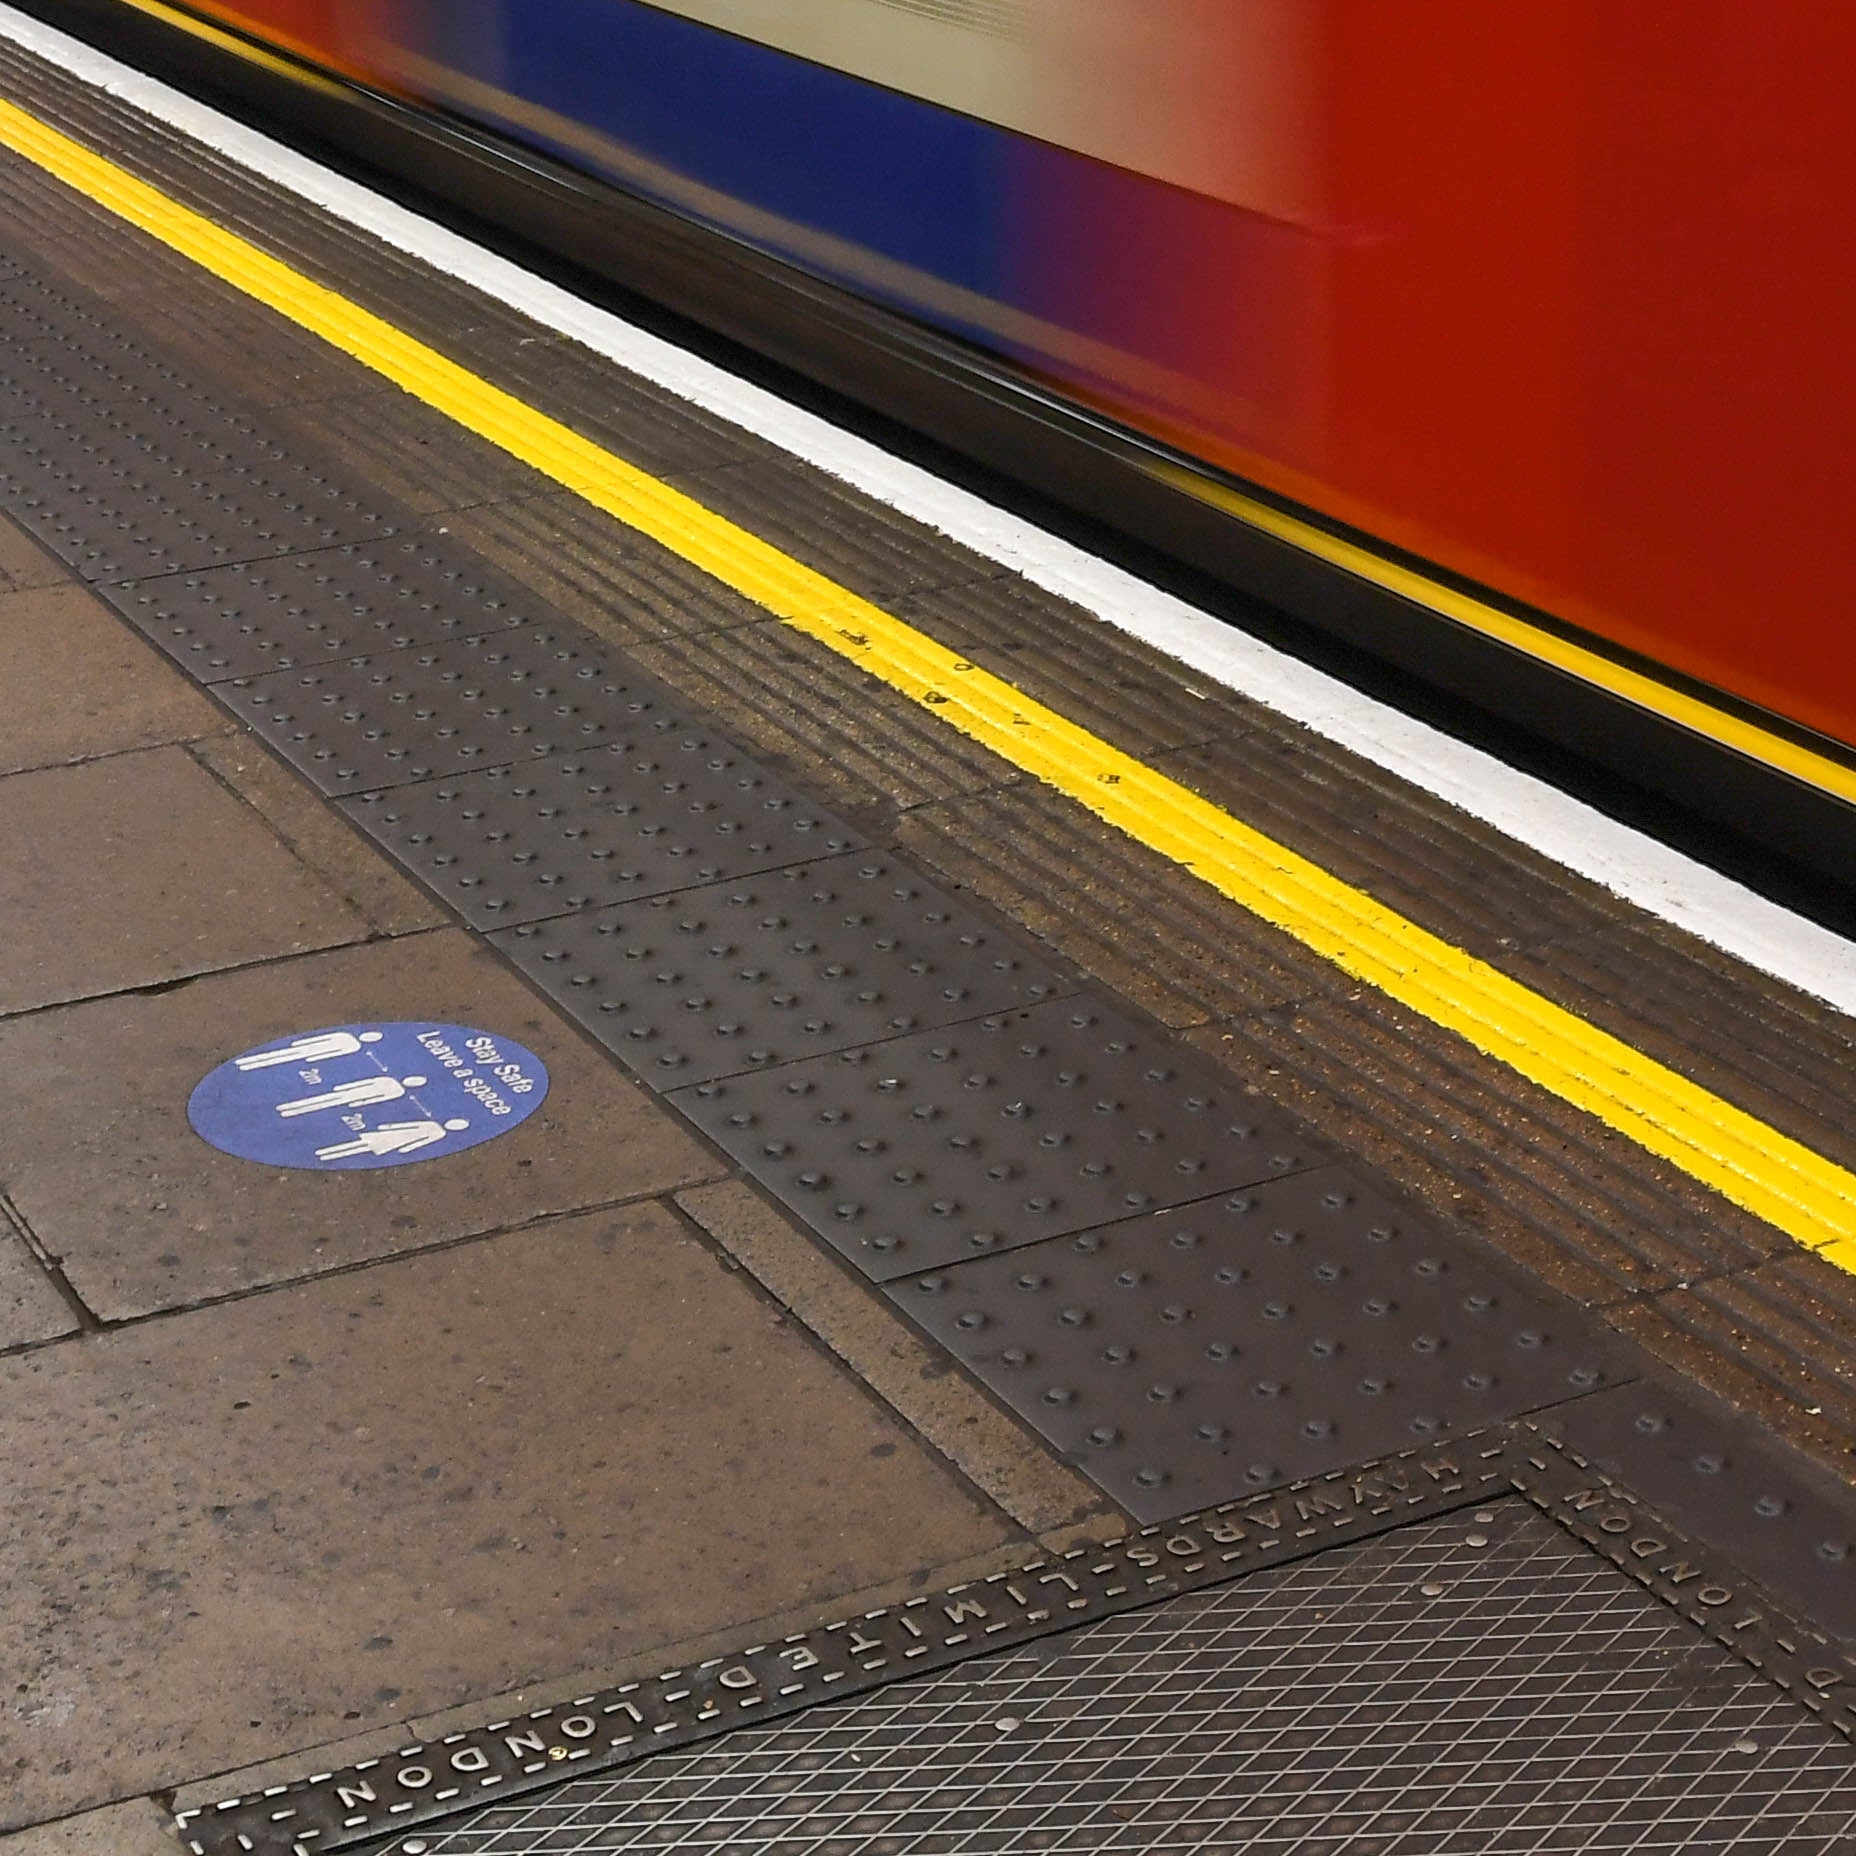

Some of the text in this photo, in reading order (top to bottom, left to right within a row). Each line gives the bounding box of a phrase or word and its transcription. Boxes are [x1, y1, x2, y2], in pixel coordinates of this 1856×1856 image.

[416, 1030, 512, 1117] Leave a space
[465, 1036, 535, 1095] Stay Safe
[336, 1455, 1460, 1809] HAYWARDS LIMITED LONDON
